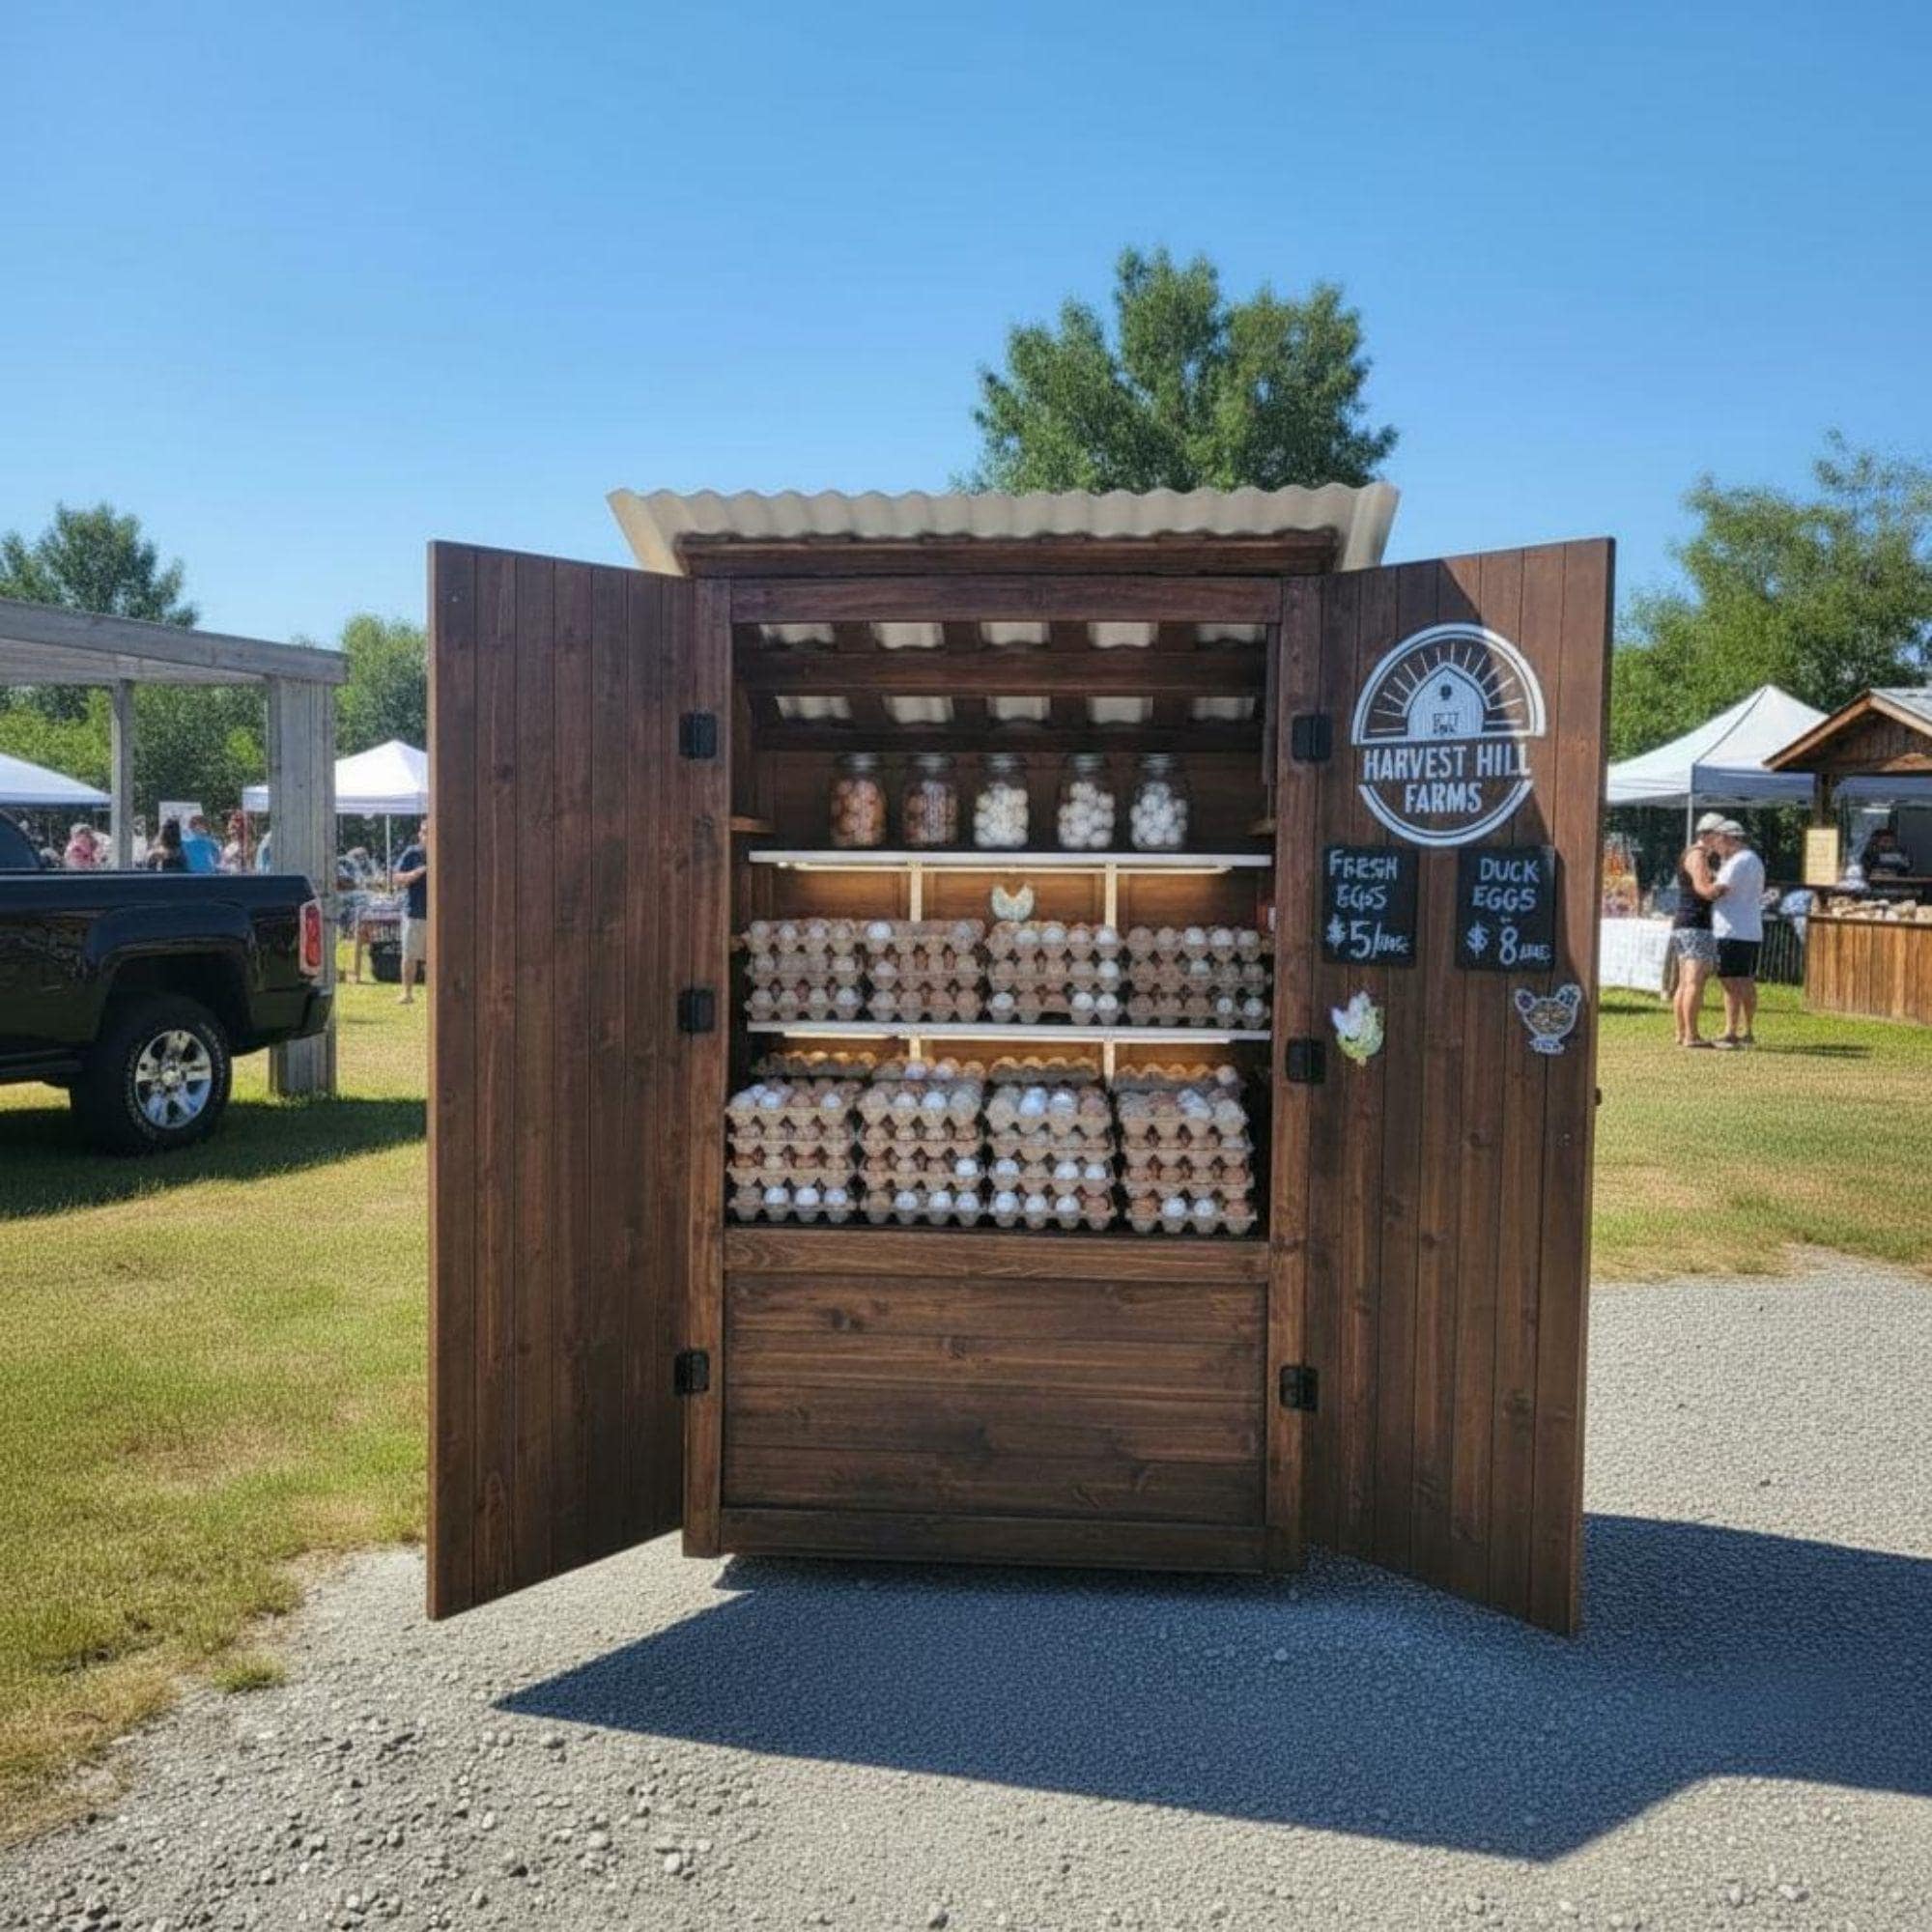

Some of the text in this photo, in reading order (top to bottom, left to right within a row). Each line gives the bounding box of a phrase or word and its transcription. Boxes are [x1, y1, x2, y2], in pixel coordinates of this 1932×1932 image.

[1363, 743, 1531, 781] HARVEST HILL
[1405, 782, 1482, 813] FARMS
[1329, 849, 1398, 880] FRESH
[1480, 858, 1540, 883] DUCK
[1472, 885, 1536, 911] EGGS
